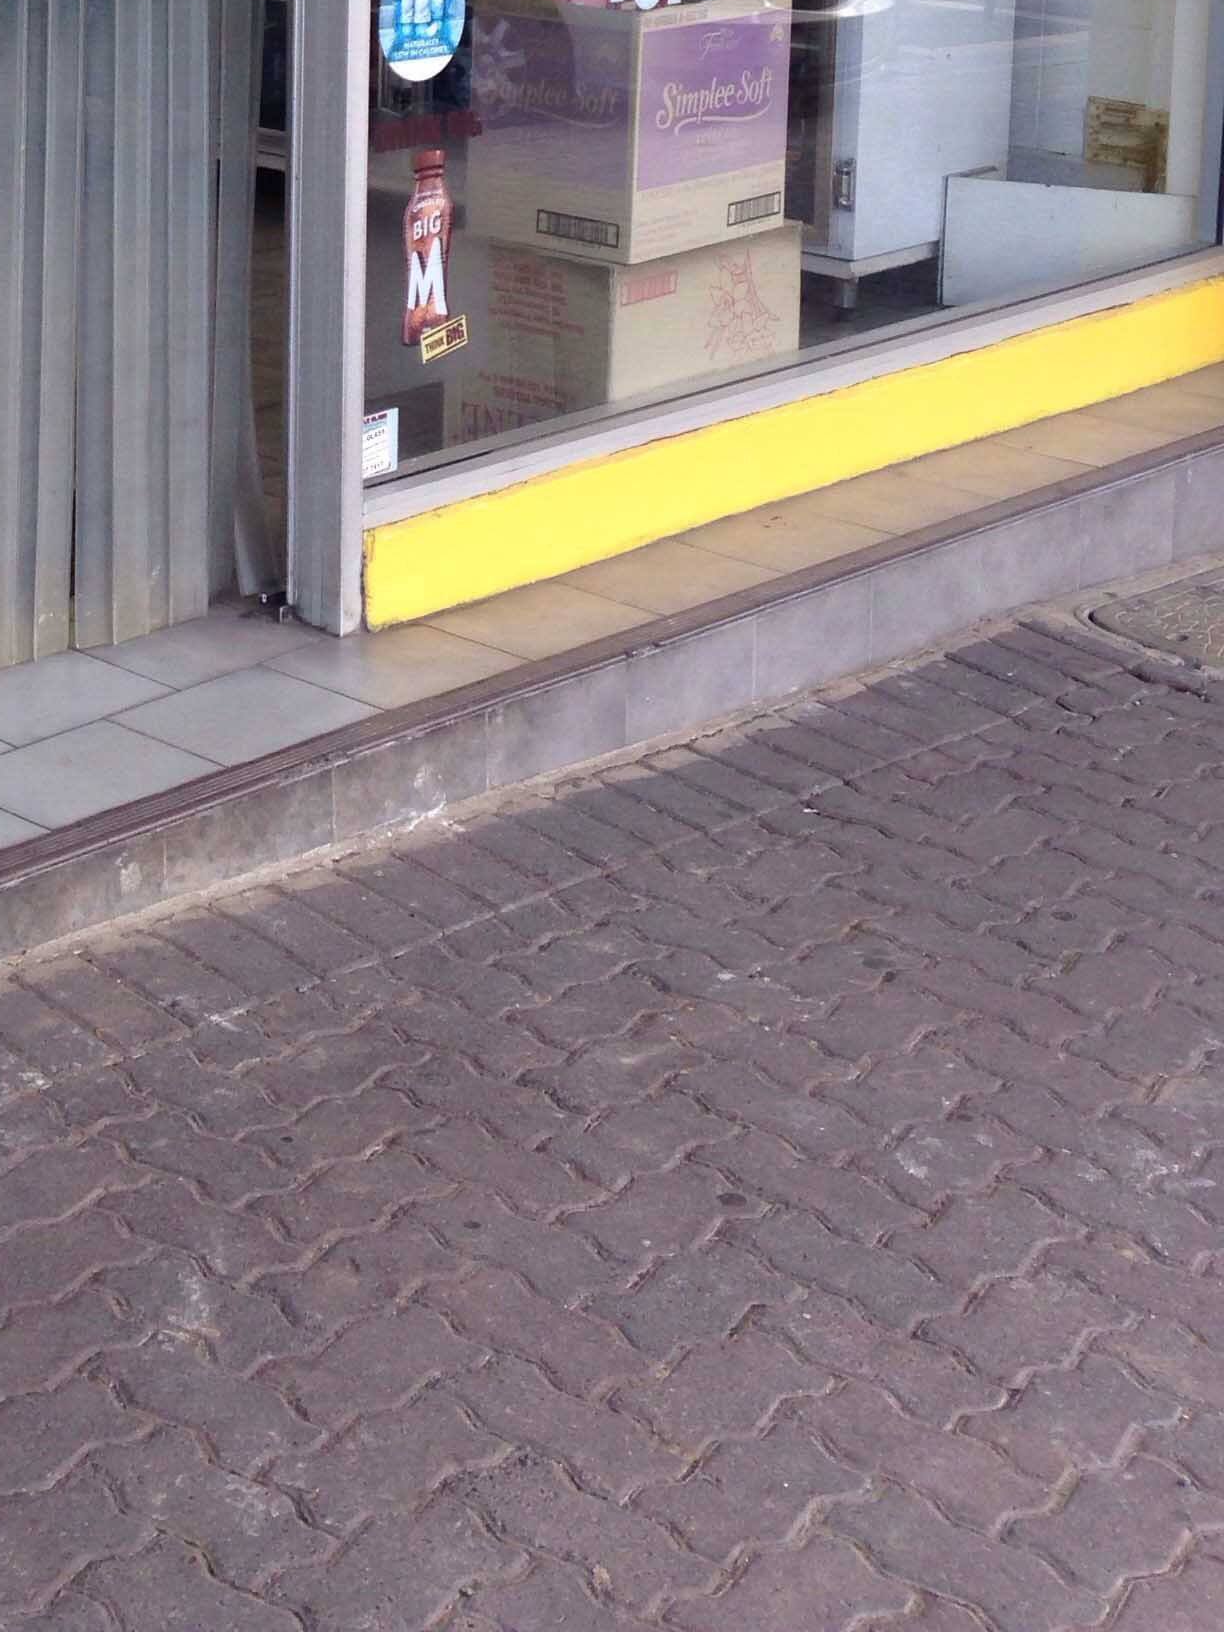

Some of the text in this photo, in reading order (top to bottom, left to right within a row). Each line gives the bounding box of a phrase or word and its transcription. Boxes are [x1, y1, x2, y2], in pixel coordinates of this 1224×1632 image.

[656, 65, 774, 130] Simplee Soft
[413, 213, 442, 241] BIG
[407, 236, 448, 316] M
[445, 322, 466, 347] BIG
